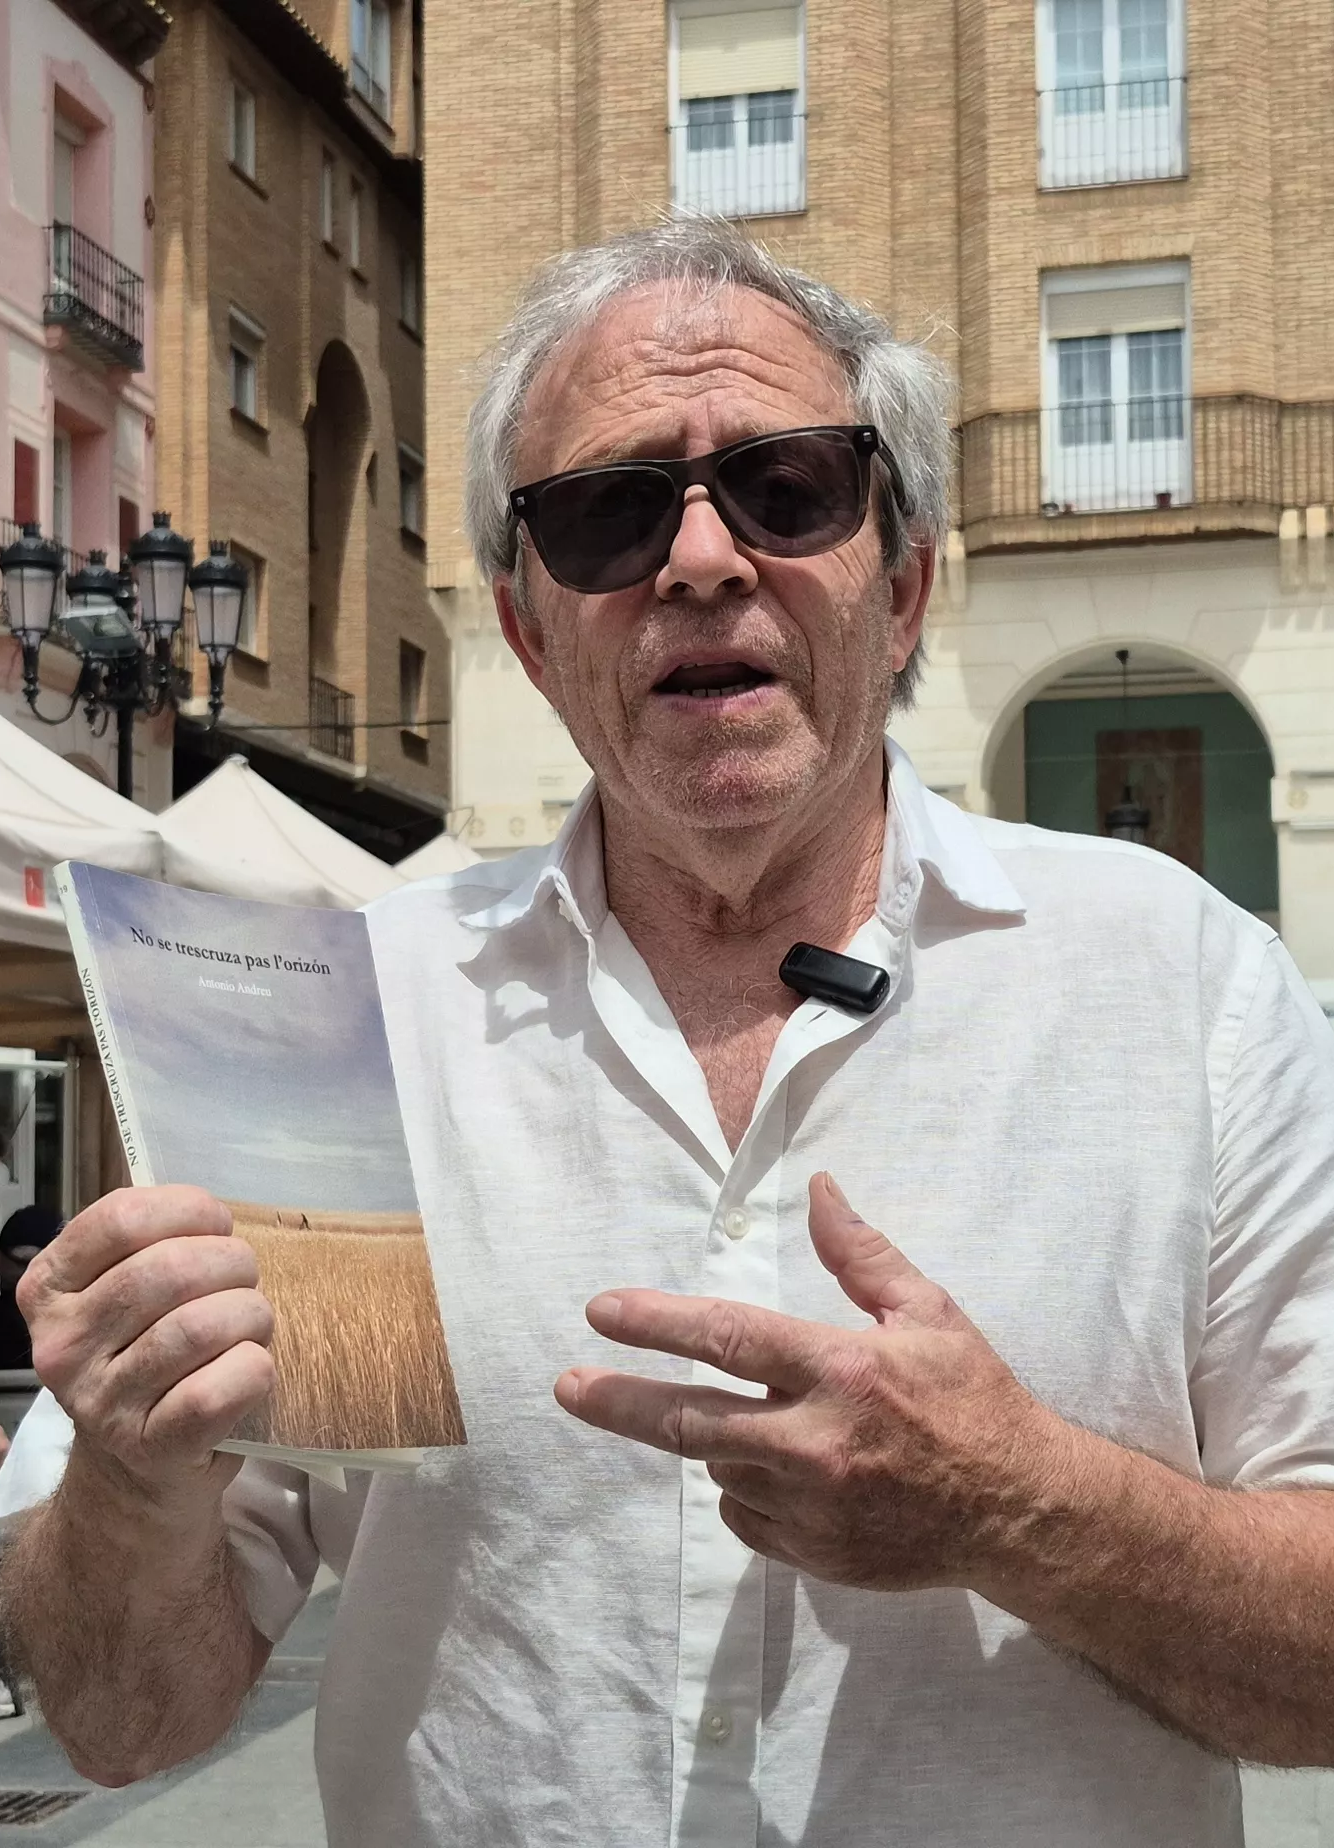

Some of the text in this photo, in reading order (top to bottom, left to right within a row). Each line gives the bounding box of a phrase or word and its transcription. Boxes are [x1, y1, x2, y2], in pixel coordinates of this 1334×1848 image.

[130, 926, 154, 947] No
[157, 937, 172, 951] se
[175, 941, 242, 965] trescruza
[244, 954, 271, 971] pas
[198, 976, 272, 997] Antonio Andreu
[97, 1029, 109, 1051] PAS
[104, 1052, 128, 1127] TRESCRUZA
[123, 1127, 133, 1144] SE
[127, 1146, 139, 1167] NO
